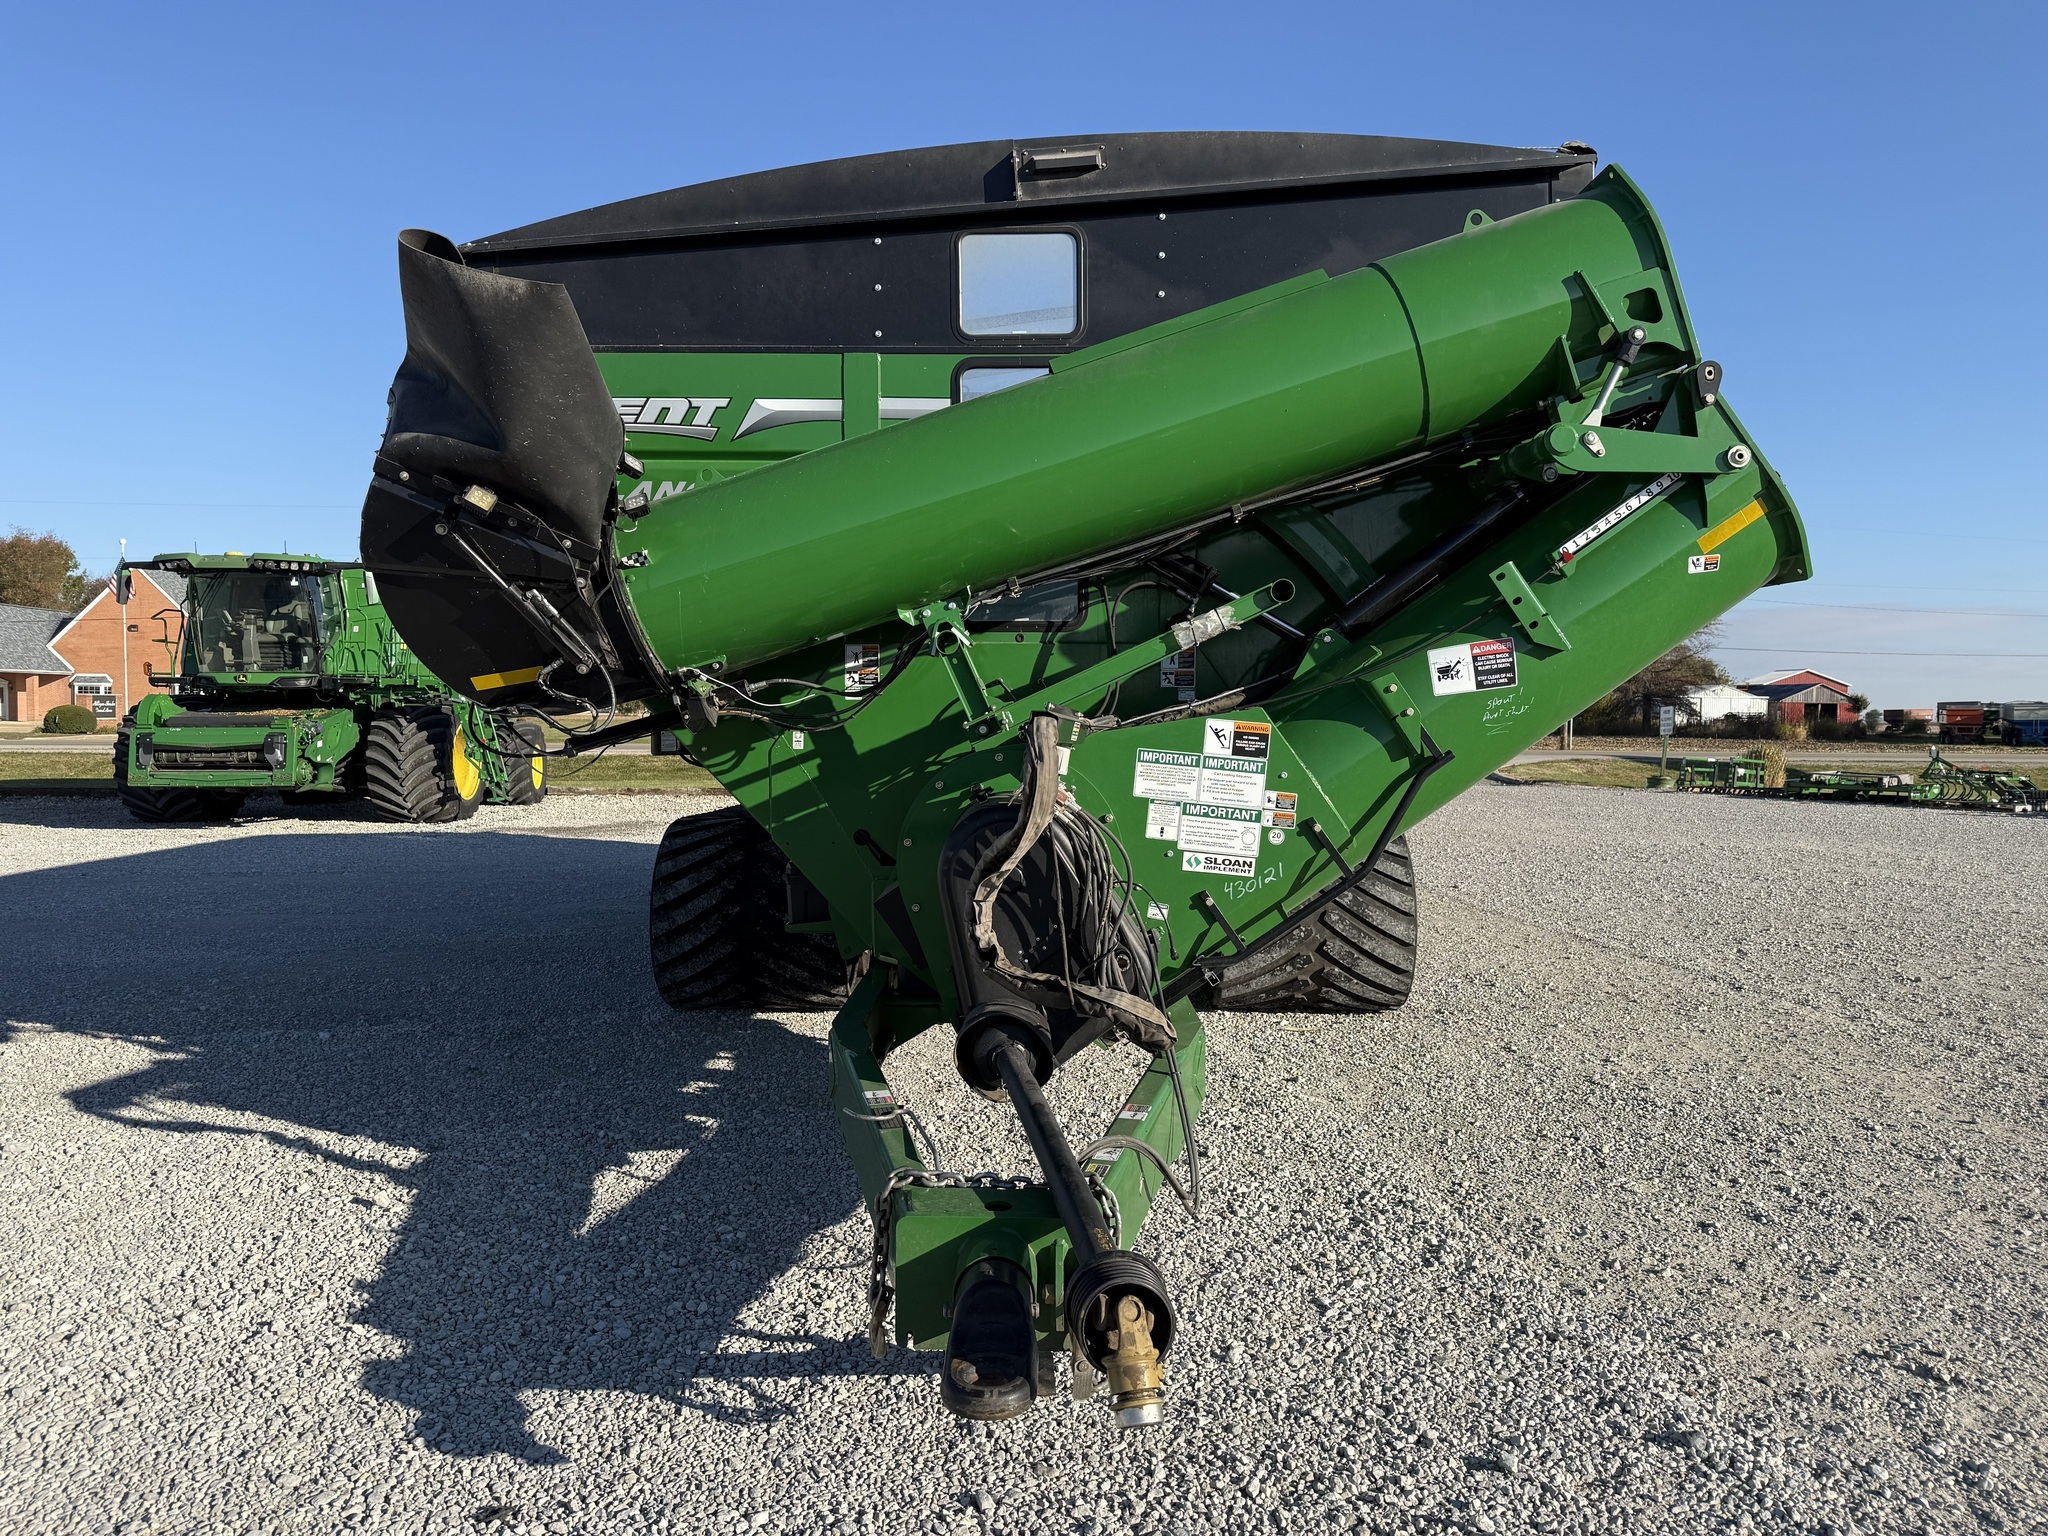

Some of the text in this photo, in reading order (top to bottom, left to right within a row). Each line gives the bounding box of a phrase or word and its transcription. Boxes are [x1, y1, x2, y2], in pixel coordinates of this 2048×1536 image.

[1572, 539, 1580, 548] 1
[1583, 532, 1591, 541] 2
[1614, 511, 1622, 520] 5
[1625, 502, 1633, 512] 6
[1634, 495, 1642, 504] 7
[1646, 487, 1654, 497] 8
[1656, 481, 1664, 490] 9
[1480, 642, 1512, 652] DANGER
[1140, 751, 1198, 766] IMPORTANT
[1205, 758, 1263, 772] IMPORTANT
[1186, 804, 1258, 821] IMPORTANT
[1271, 831, 1281, 839] 20
[1203, 865, 1252, 874] IMPLEMENT
[1204, 857, 1253, 868] SLOAN
[1224, 862, 1283, 900] 430121
